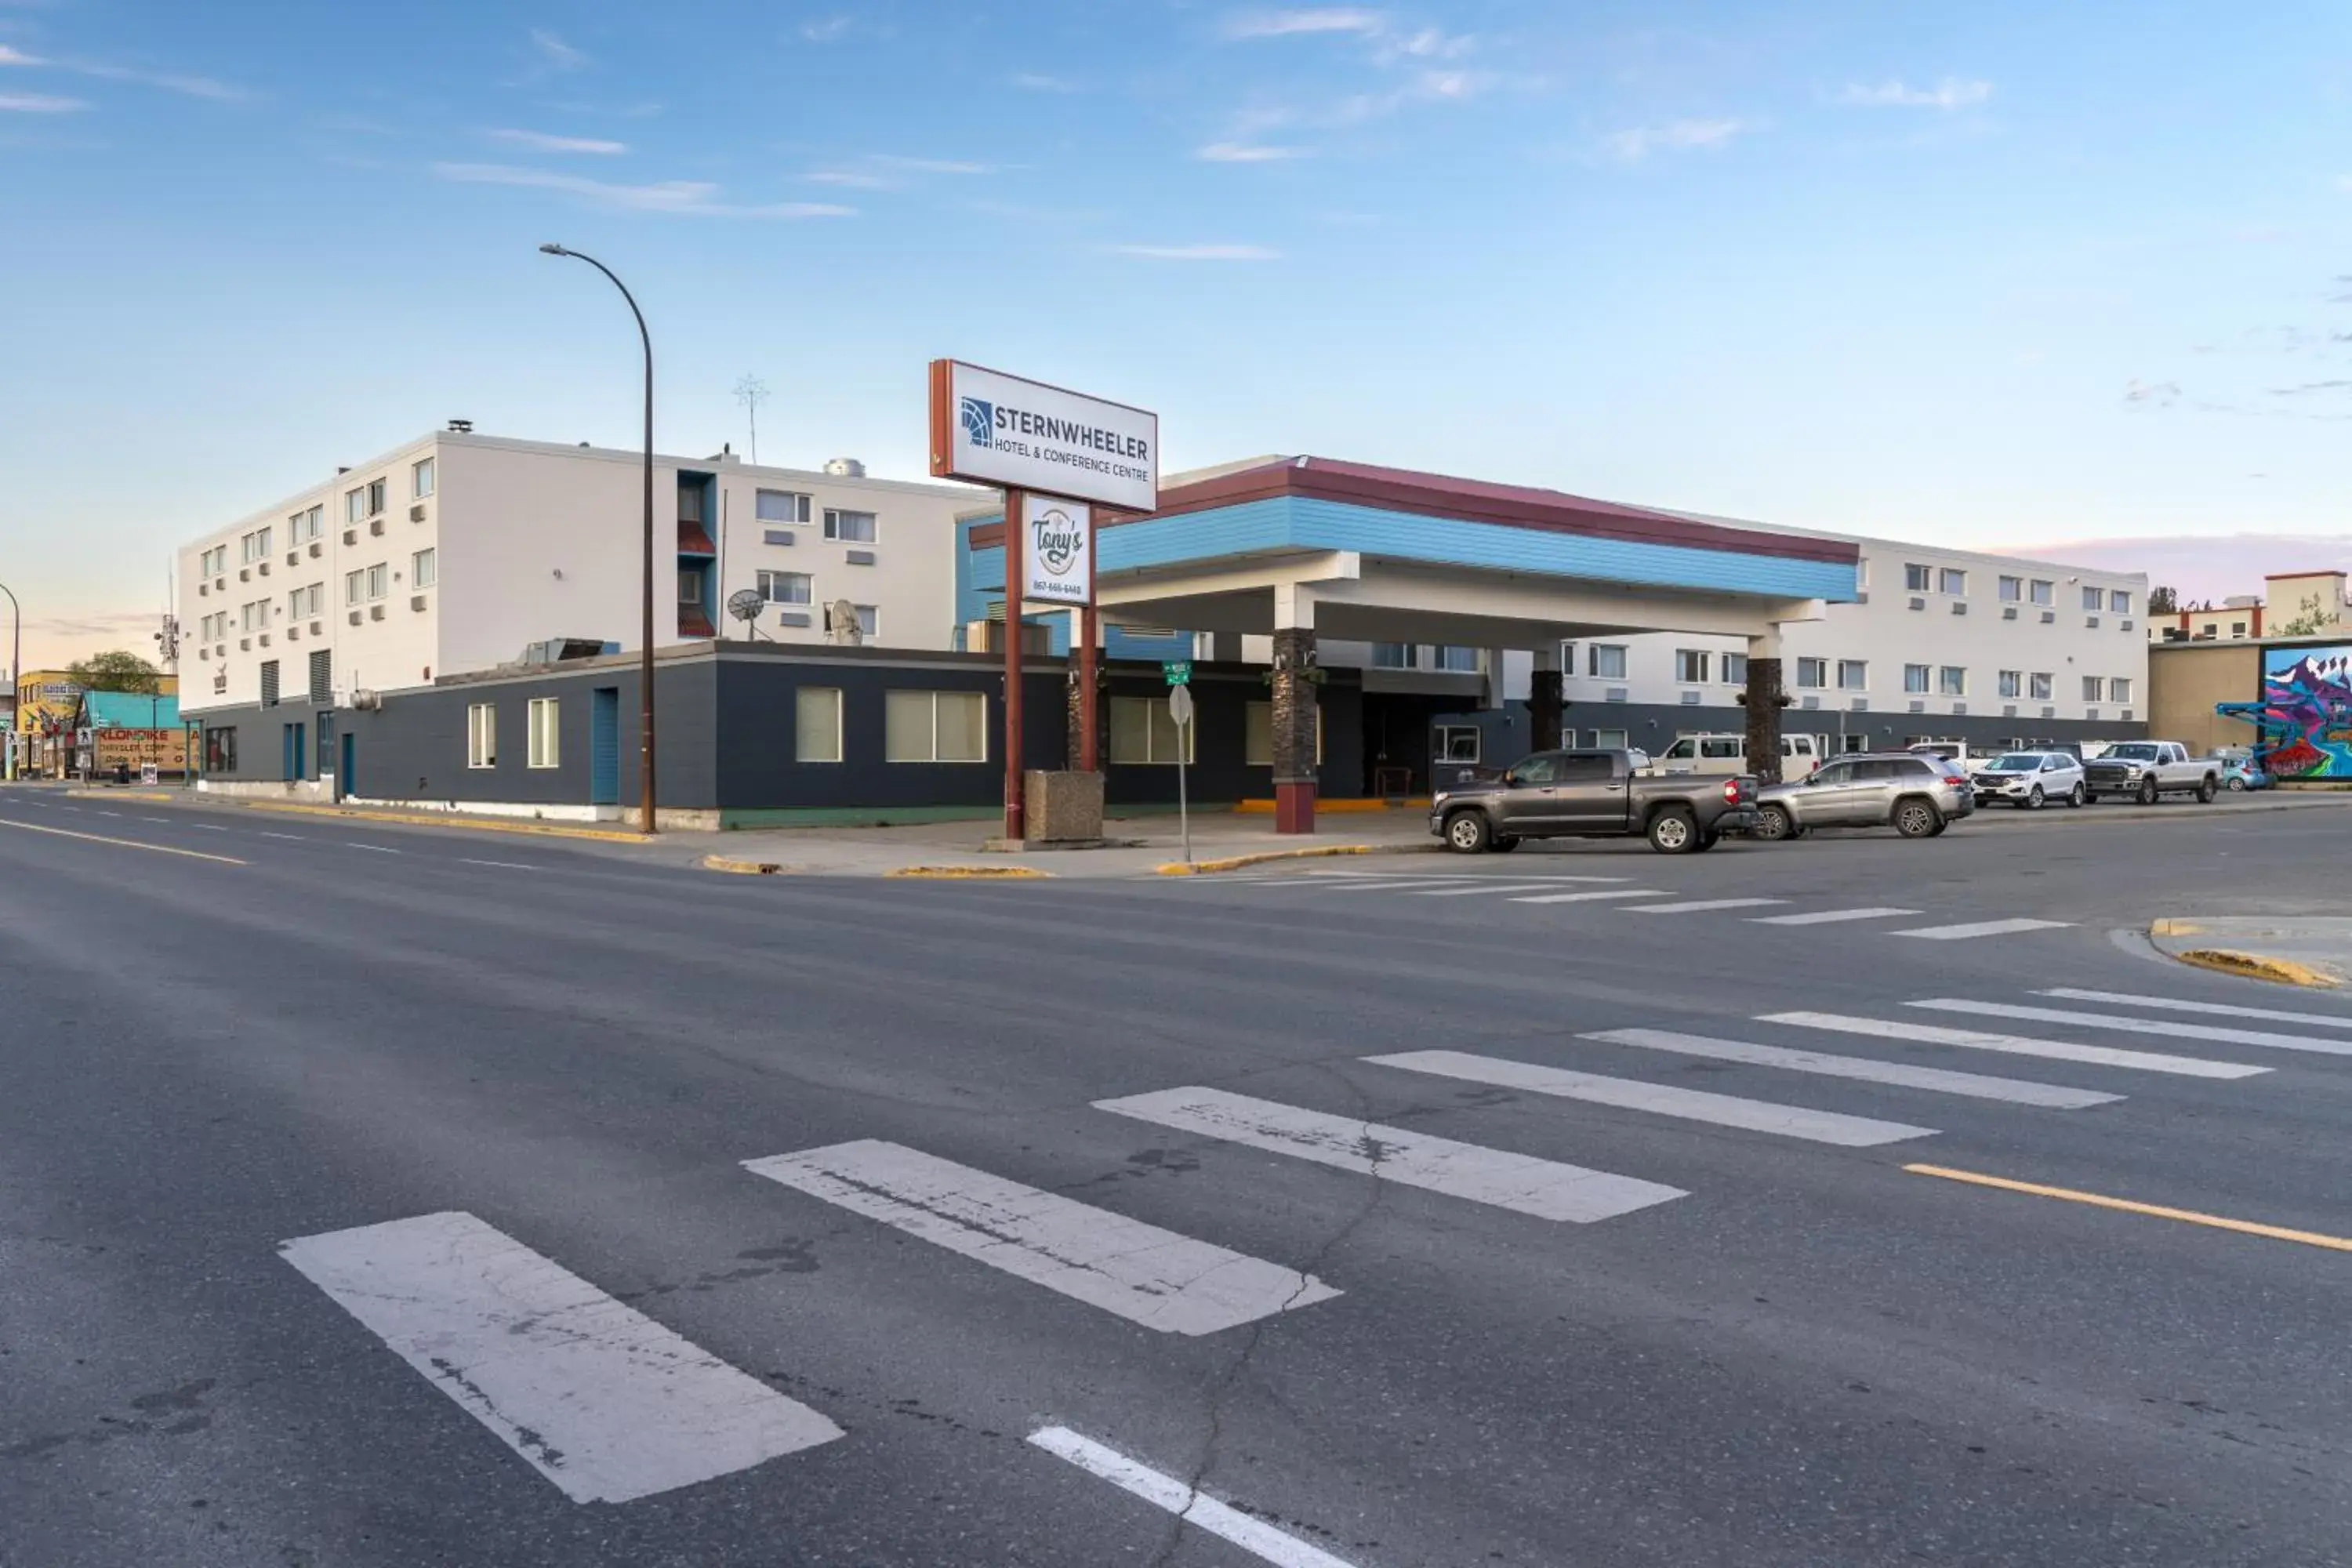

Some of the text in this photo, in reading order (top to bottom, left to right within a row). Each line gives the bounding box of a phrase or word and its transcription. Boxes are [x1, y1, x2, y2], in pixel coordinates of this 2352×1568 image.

[995, 405, 1149, 462] STERNWHEELER
[995, 438, 1149, 482] HOTEL & CONFERENCE CENTRE
[1032, 519, 1083, 565] Tony's
